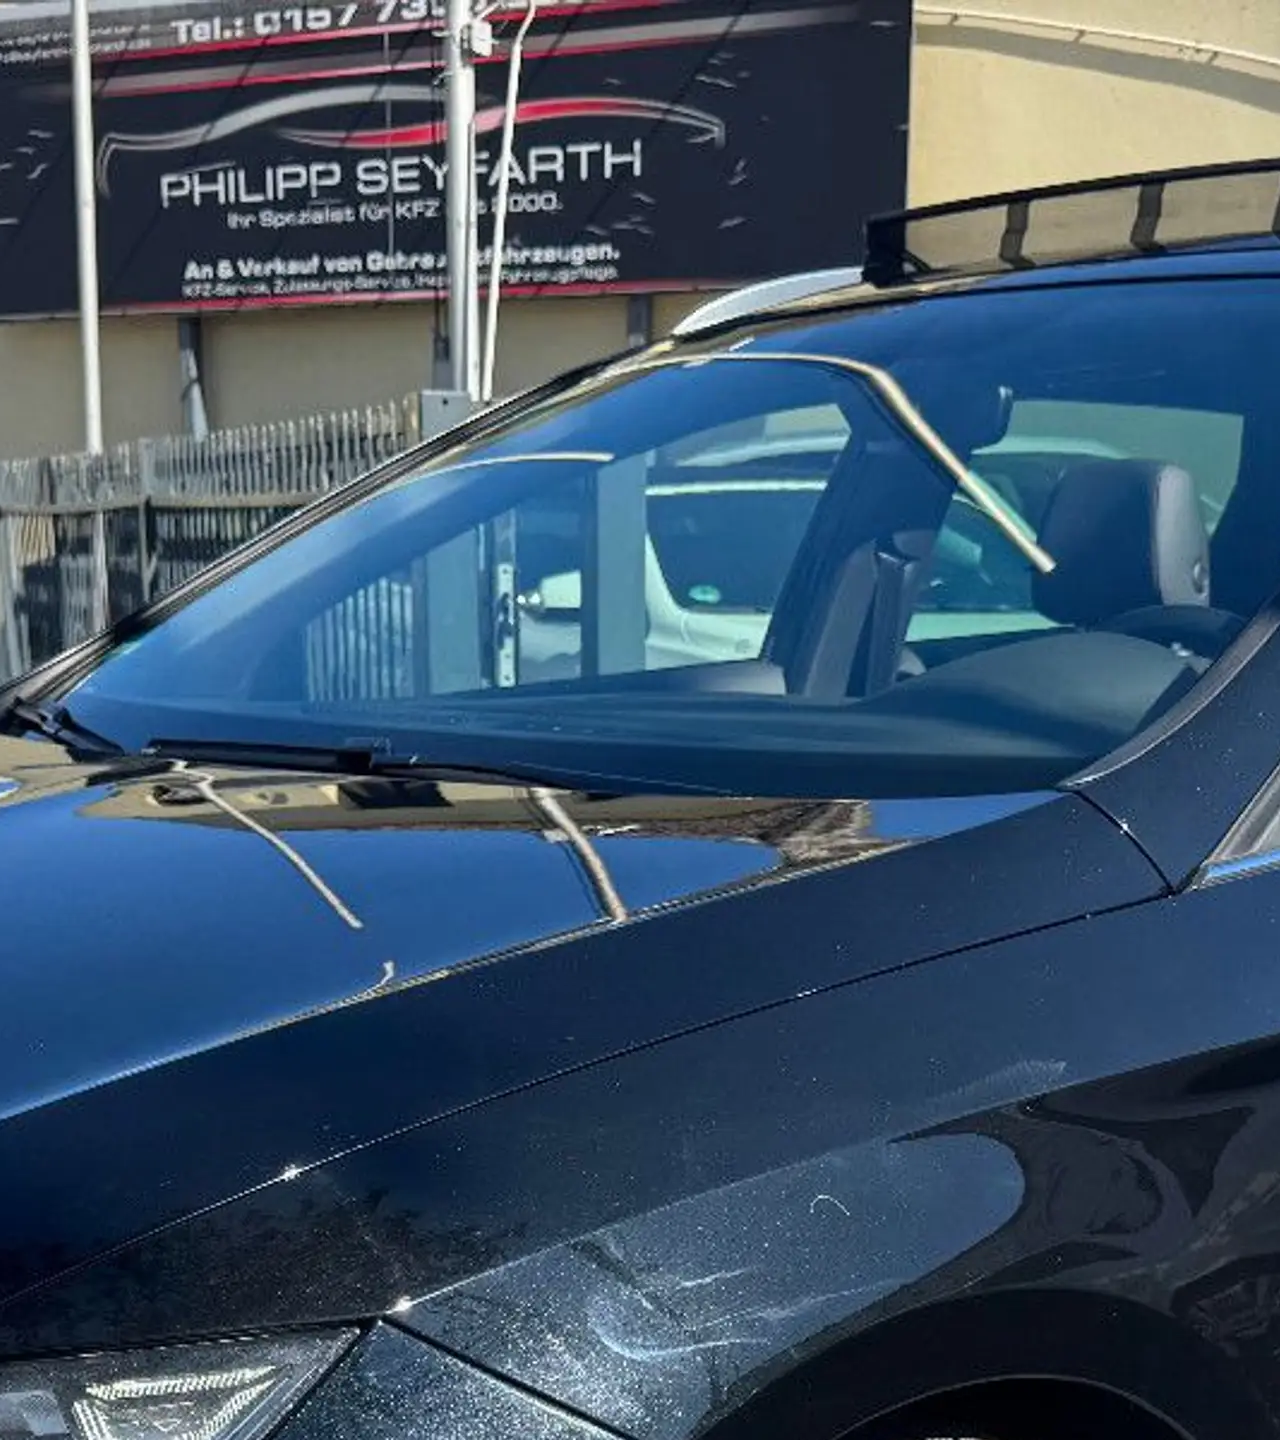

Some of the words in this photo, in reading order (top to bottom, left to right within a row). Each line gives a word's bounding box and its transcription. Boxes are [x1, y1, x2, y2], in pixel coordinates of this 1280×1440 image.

[171, 16, 244, 43] Tel.:
[160, 161, 341, 208] PHILIPP
[356, 138, 641, 195] SEYFARTH
[227, 211, 257, 229] Ihr
[395, 200, 440, 219] KFZ
[184, 260, 214, 281] An
[217, 258, 234, 279] &
[237, 253, 320, 278] Verkauf
[323, 256, 363, 273] von
